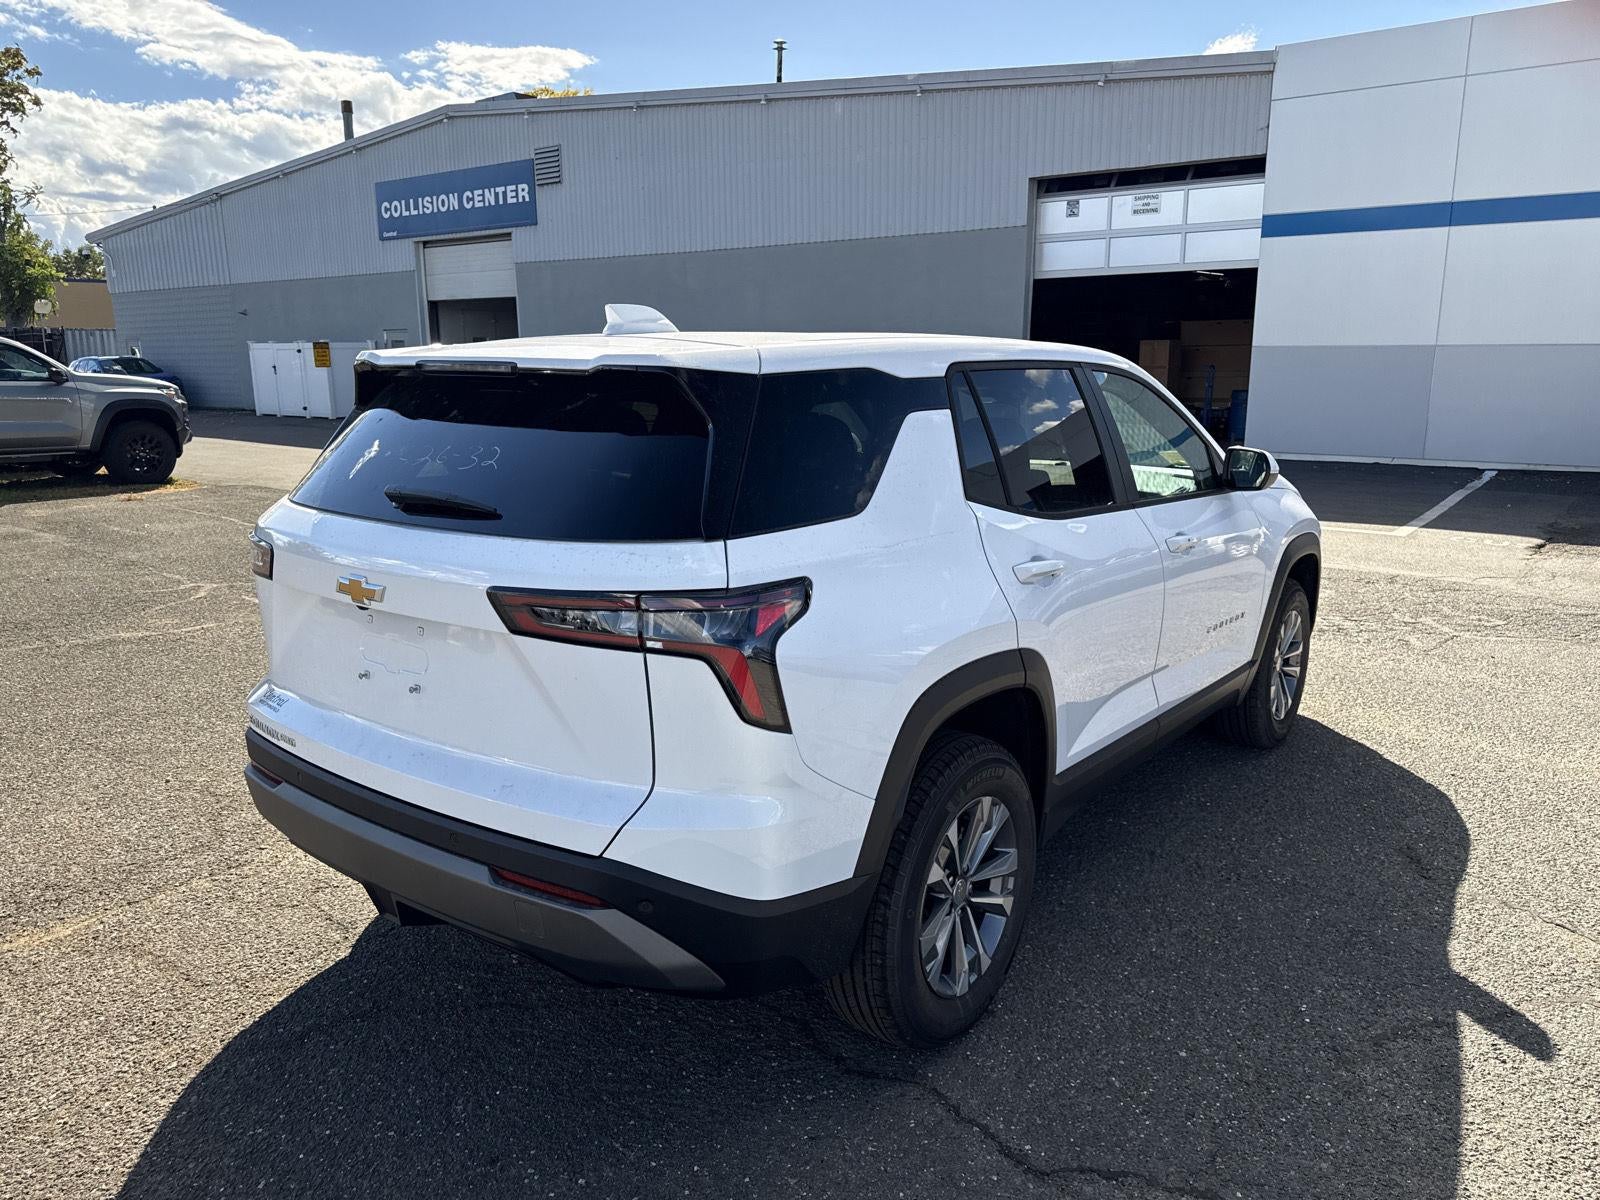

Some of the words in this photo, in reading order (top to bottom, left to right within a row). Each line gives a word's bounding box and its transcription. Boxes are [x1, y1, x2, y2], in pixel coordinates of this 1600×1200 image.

[381, 192, 459, 219] COLLISION
[462, 183, 530, 209] CENTER
[1134, 194, 1160, 202] SHIPPING
[1133, 207, 1159, 215] RECEIVING
[966, 766, 1006, 790] MICHELIN
